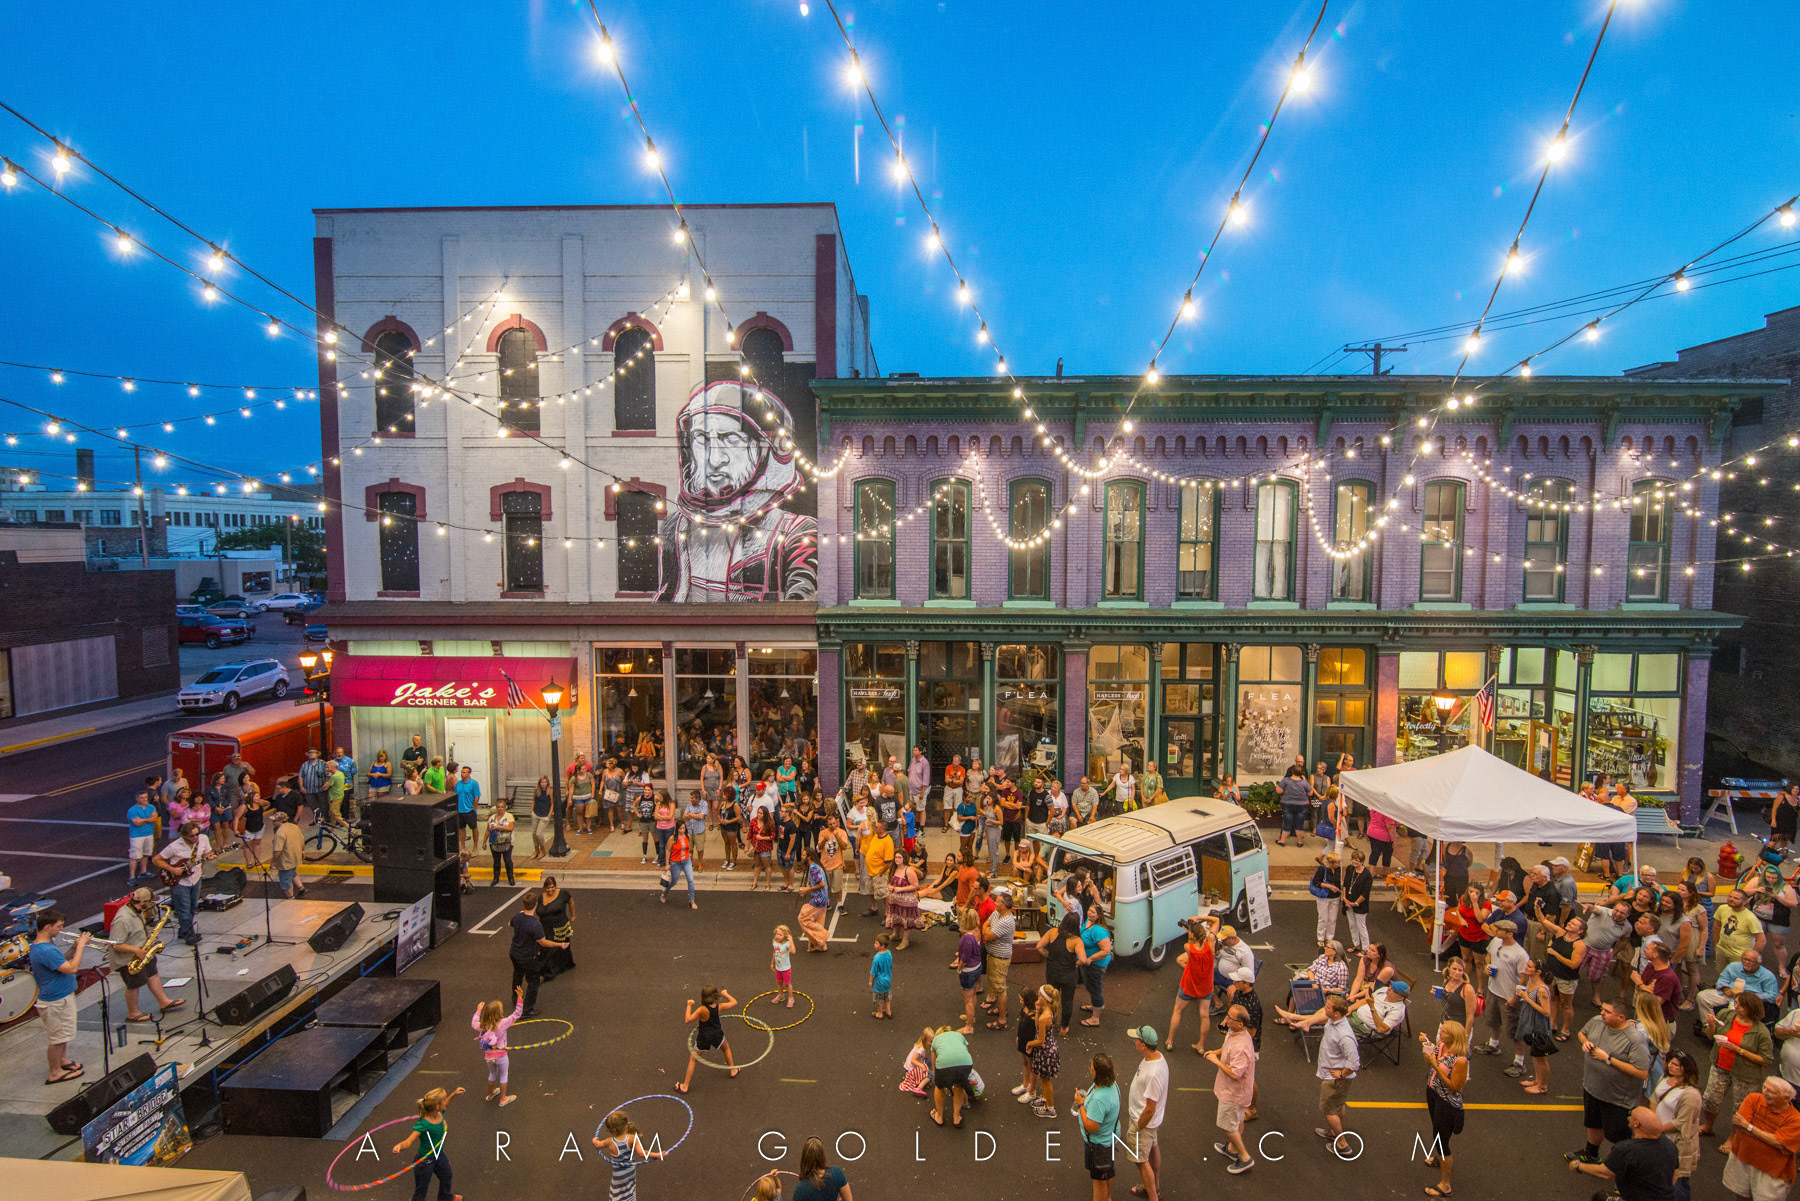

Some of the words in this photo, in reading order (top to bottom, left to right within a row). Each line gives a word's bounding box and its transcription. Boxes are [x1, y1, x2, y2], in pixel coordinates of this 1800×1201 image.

[390, 682, 496, 705] Jake's
[1248, 692, 1291, 700] FLEA
[407, 698, 457, 706] CORNER
[463, 698, 488, 706] BAR
[1404, 721, 1437, 732] Perfectly
[105, 1119, 130, 1143] STAR
[137, 1091, 166, 1119] BRIDGE
